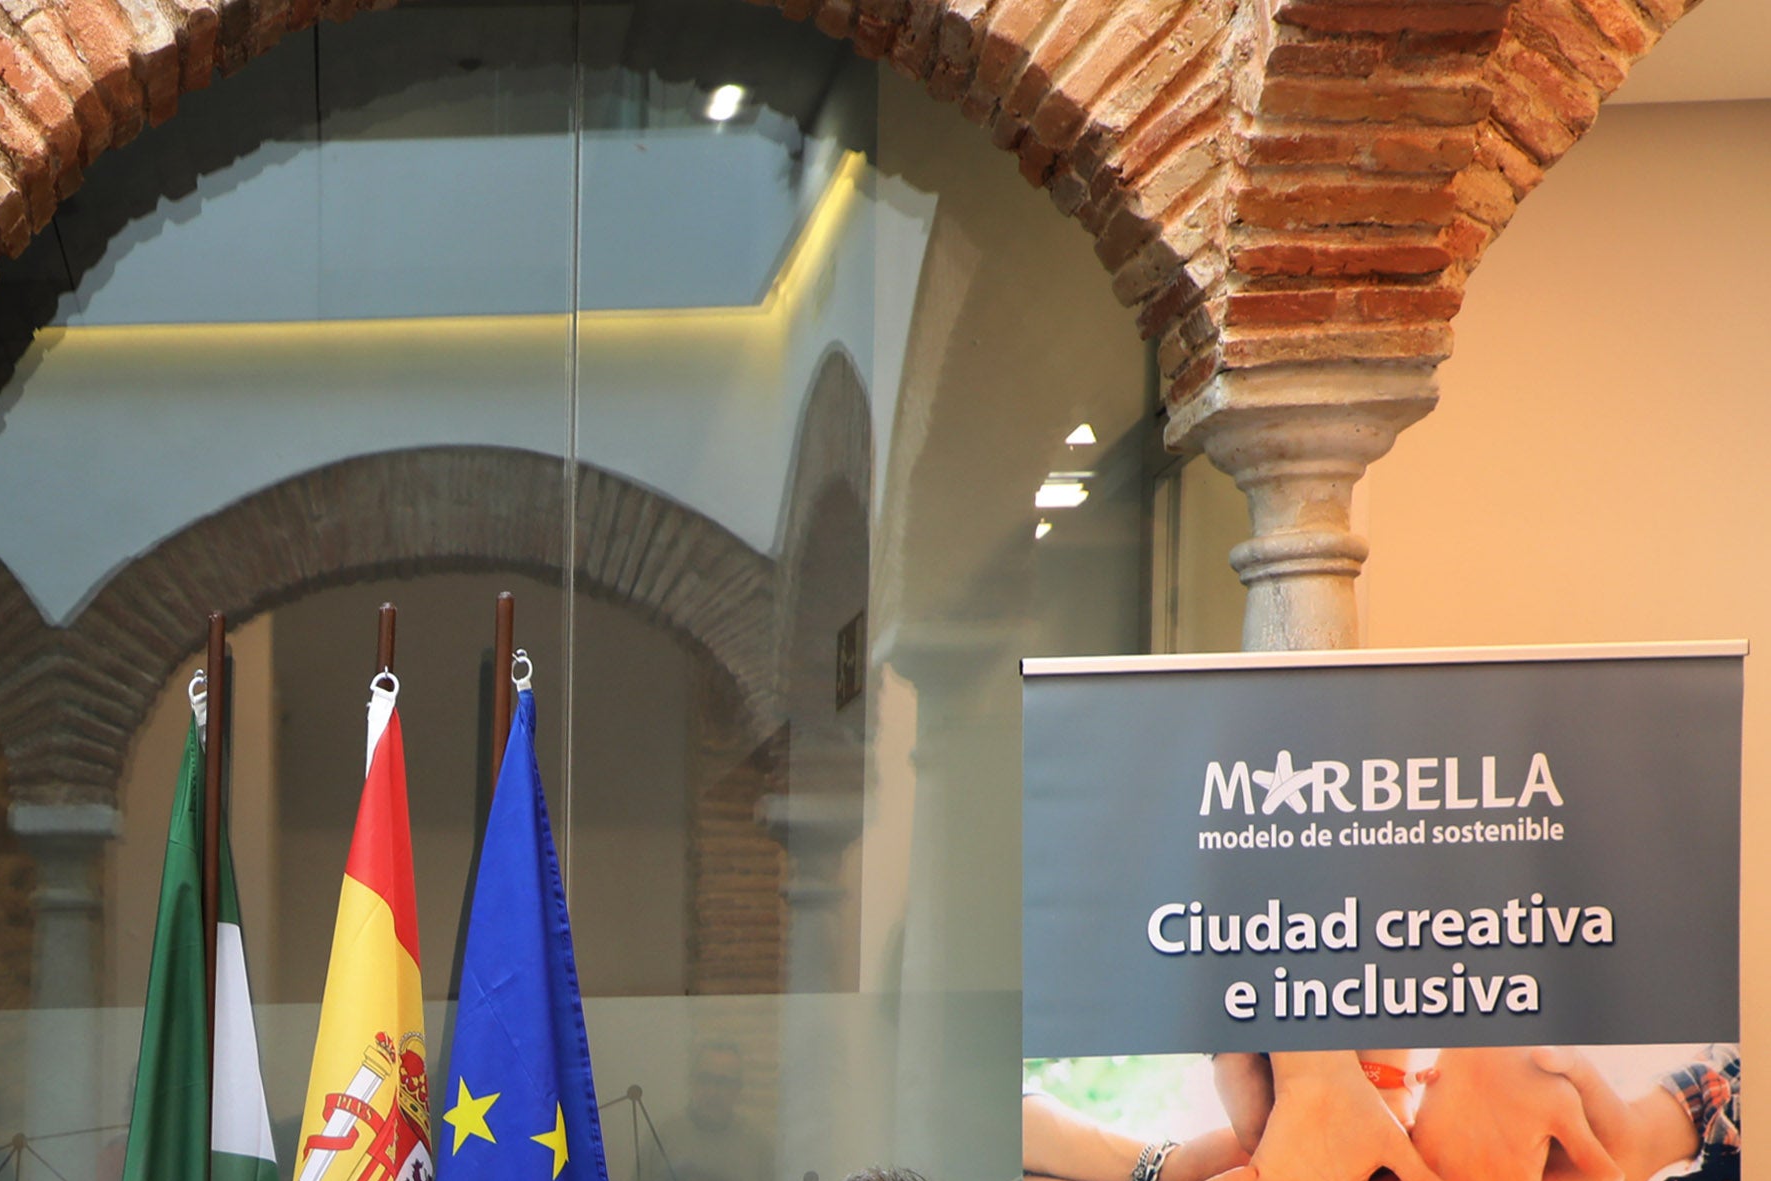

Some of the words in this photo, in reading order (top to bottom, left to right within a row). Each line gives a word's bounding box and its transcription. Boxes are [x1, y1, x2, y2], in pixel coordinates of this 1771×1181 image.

[1198, 750, 1565, 816] MARBELLA
[1198, 824, 1295, 850] modelo
[1300, 822, 1333, 847] de
[1338, 819, 1426, 846] ciudad
[1431, 816, 1565, 844] sostenible
[1146, 896, 1359, 955] Ciudad
[1374, 893, 1615, 948] creativa
[1225, 979, 1258, 1019] e
[1274, 961, 1540, 1018] inclusiva
